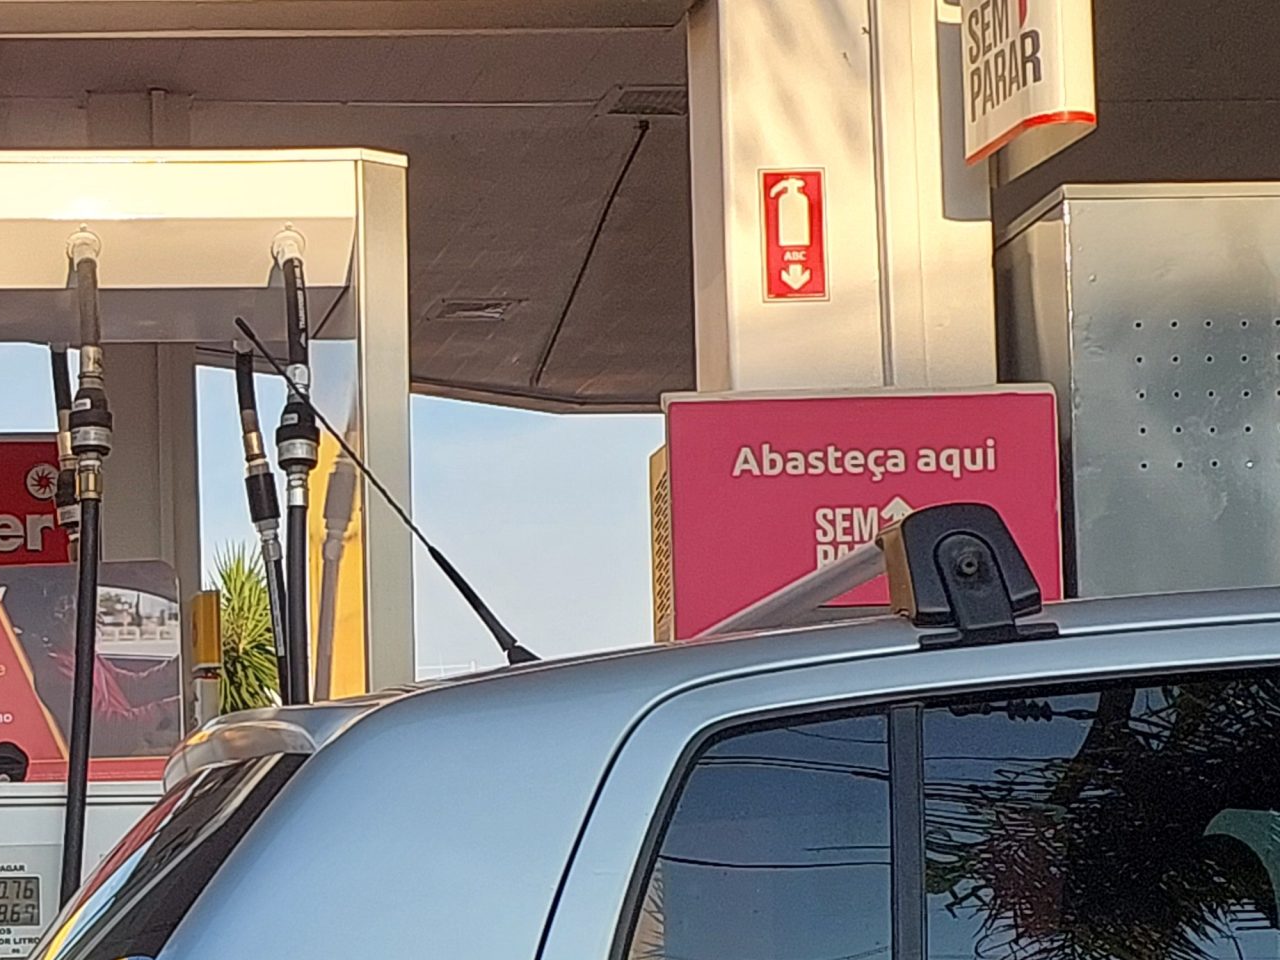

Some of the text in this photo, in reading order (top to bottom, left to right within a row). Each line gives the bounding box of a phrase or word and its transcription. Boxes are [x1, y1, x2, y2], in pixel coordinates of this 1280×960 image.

[968, 0, 1009, 64] SEM
[970, 29, 1042, 123] PARAR
[783, 250, 807, 261] ABC
[732, 438, 996, 481] Abasteça aqui
[815, 507, 879, 542] SEM
